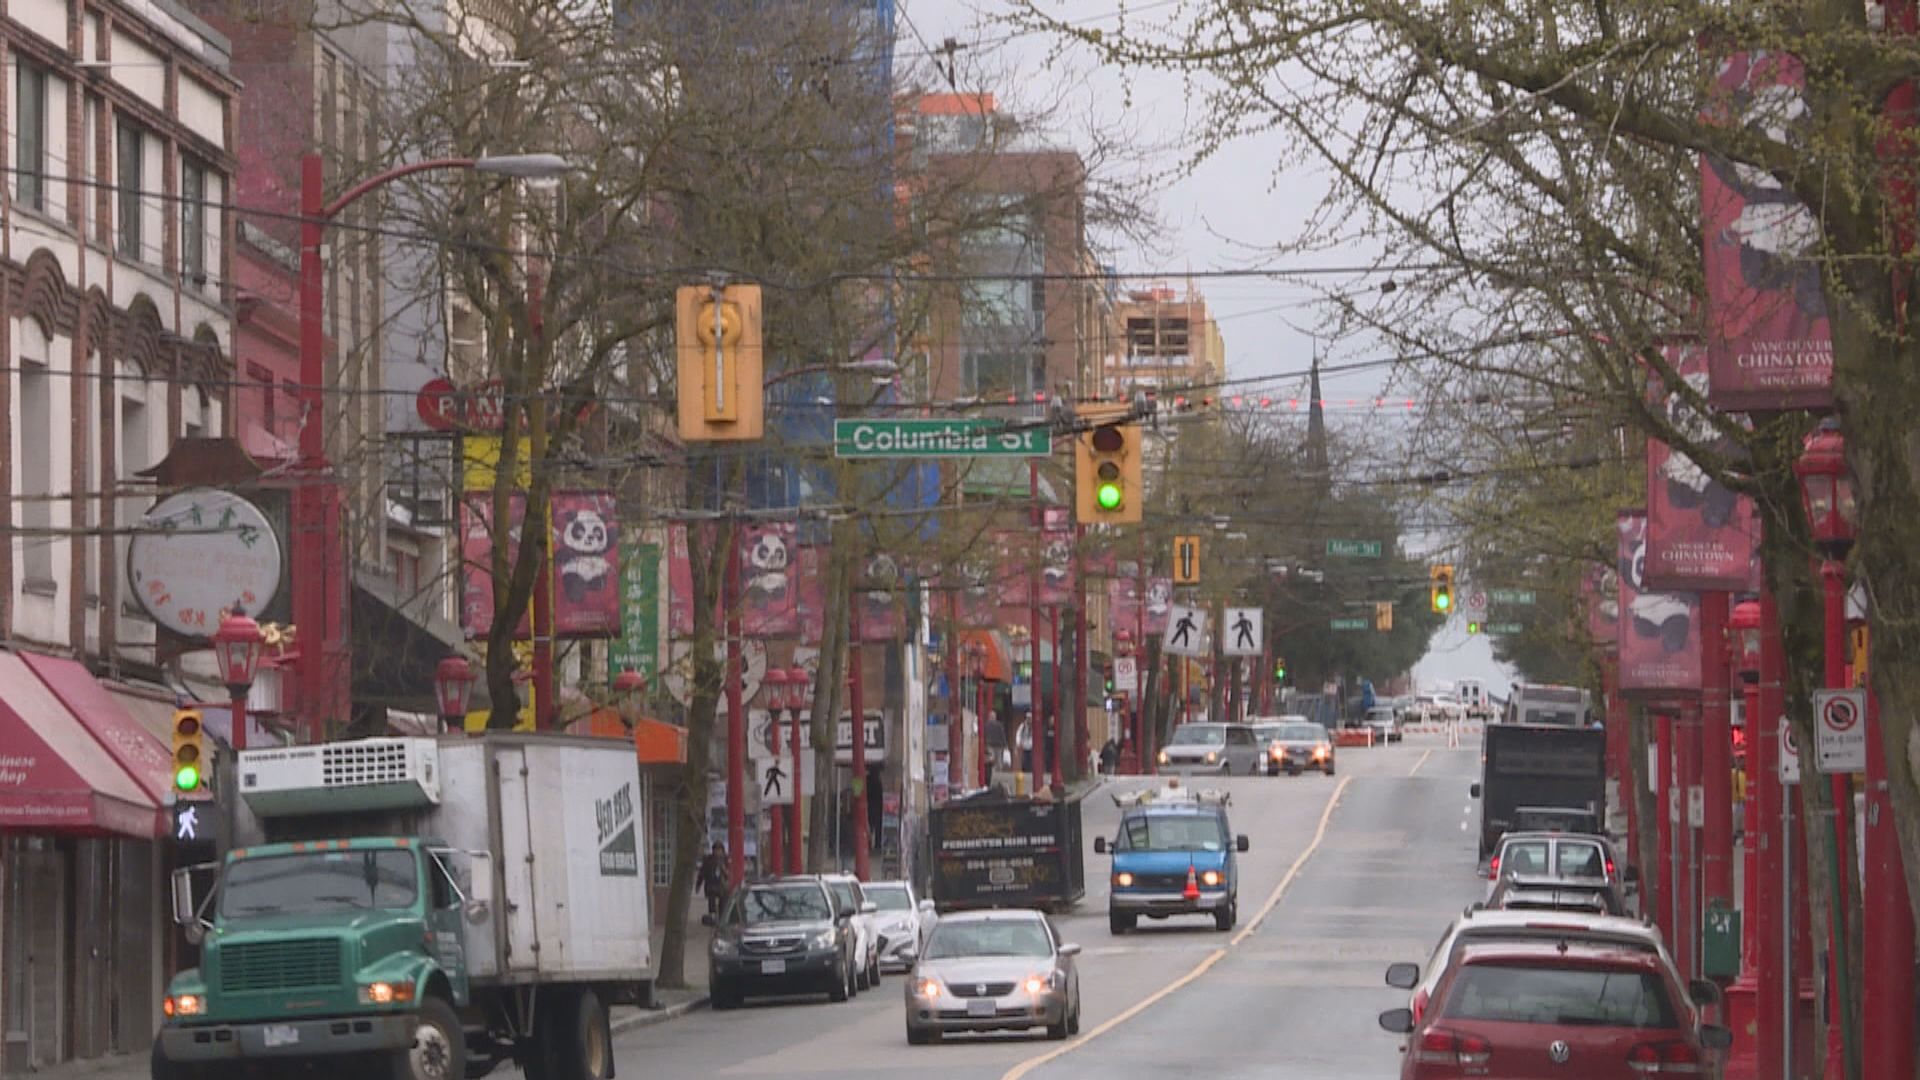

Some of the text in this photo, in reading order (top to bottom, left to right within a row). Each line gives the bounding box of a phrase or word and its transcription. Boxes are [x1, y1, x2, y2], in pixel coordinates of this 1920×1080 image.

[1737, 352, 1833, 368] CHINATOW
[853, 425, 1033, 450] Columbia St
[1661, 550, 1735, 562] CHINATOWN
